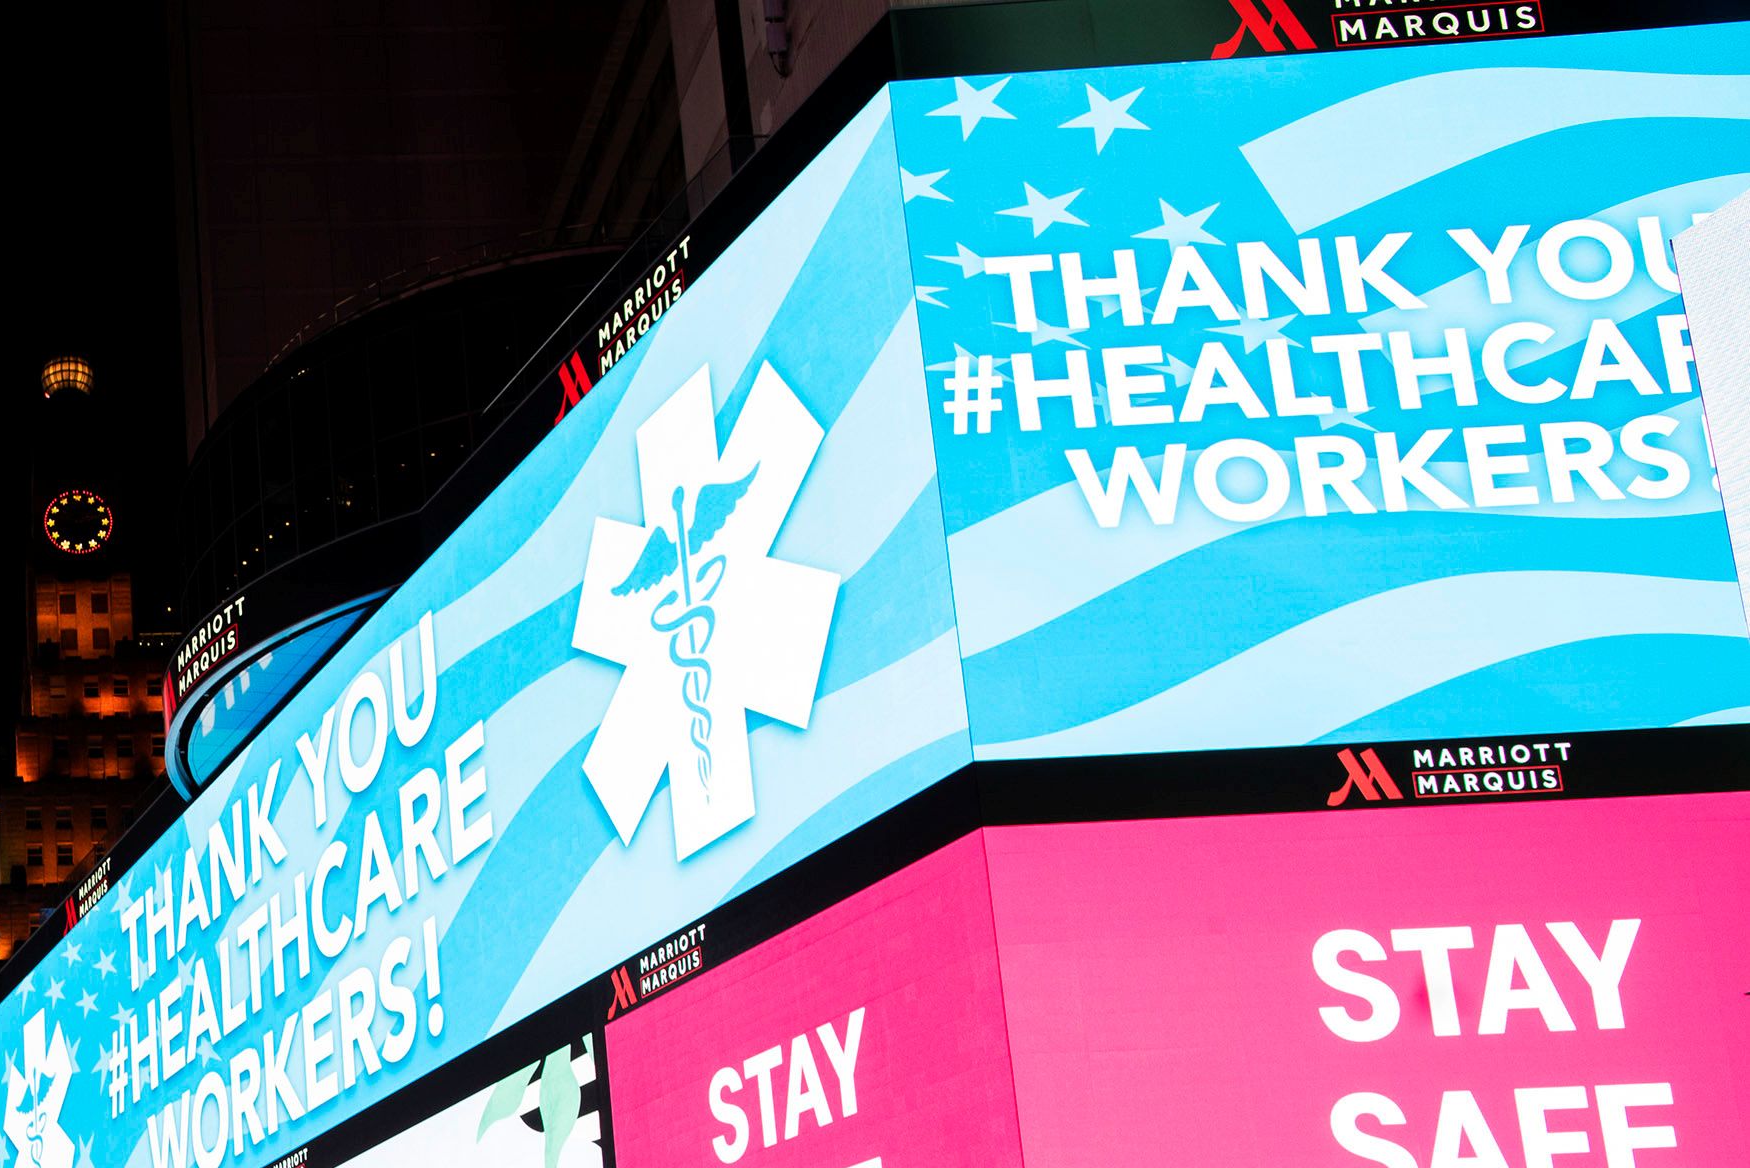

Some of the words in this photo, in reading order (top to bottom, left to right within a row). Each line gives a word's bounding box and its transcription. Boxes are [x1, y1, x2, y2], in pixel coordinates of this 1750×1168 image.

[1340, 5, 1538, 44] MARQUIS
[598, 235, 692, 349] MARRIOTT
[985, 231, 1429, 333] THANK
[600, 277, 684, 377] MARQUIS
[176, 596, 246, 674] MARRIOTT
[178, 629, 238, 697] MARQUIS
[1411, 741, 1572, 768] MARRIOTT
[1416, 767, 1560, 794] MARQUIS
[120, 757, 288, 994] THANK
[295, 608, 439, 830] YOU
[78, 857, 112, 900] MARRIOTT
[79, 882, 110, 918] MARQUIS
[107, 719, 496, 1120] #HEALTHCARE
[640, 923, 707, 974] MARRIOTT
[640, 950, 701, 996] MARQUIS
[1310, 916, 1641, 1044] STAY
[706, 1006, 867, 1165] STAY
